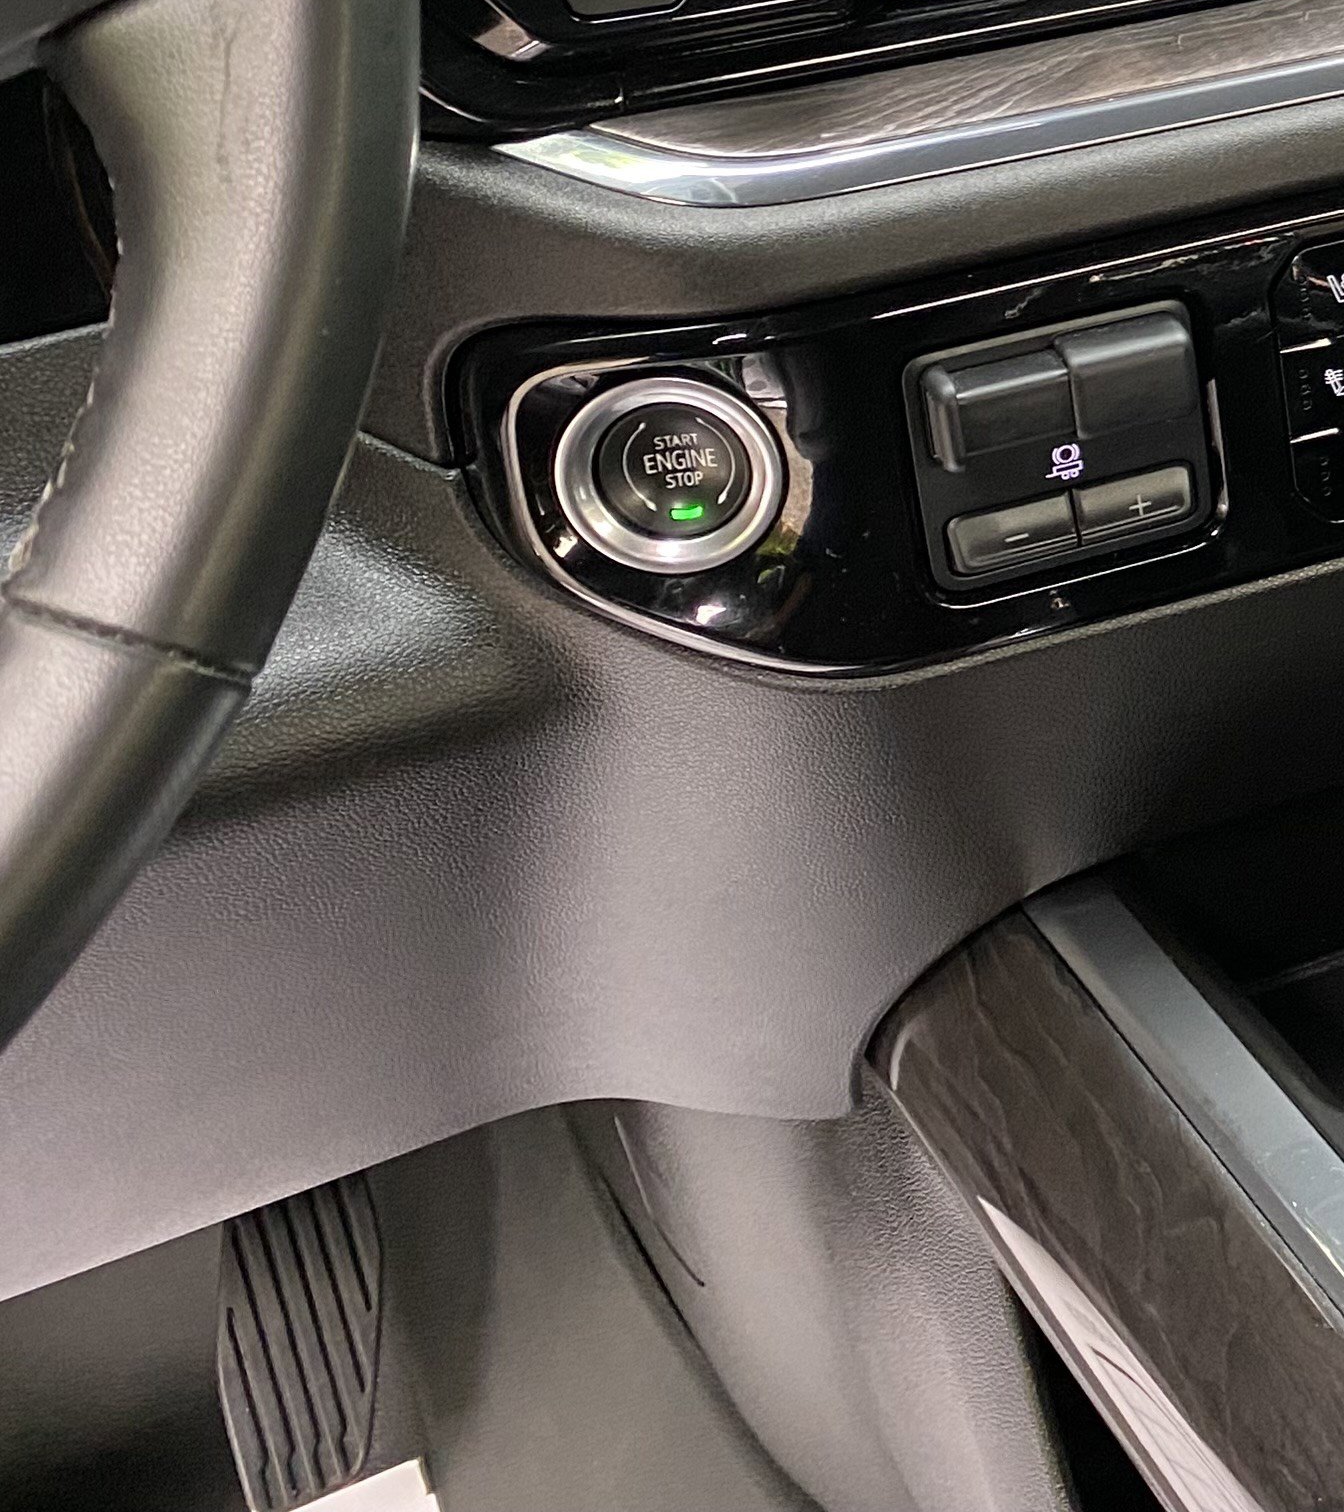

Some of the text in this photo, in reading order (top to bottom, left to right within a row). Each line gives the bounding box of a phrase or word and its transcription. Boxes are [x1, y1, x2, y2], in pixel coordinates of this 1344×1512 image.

[653, 433, 698, 451] START
[643, 448, 718, 475] ENGINE
[665, 471, 704, 489] STOP
